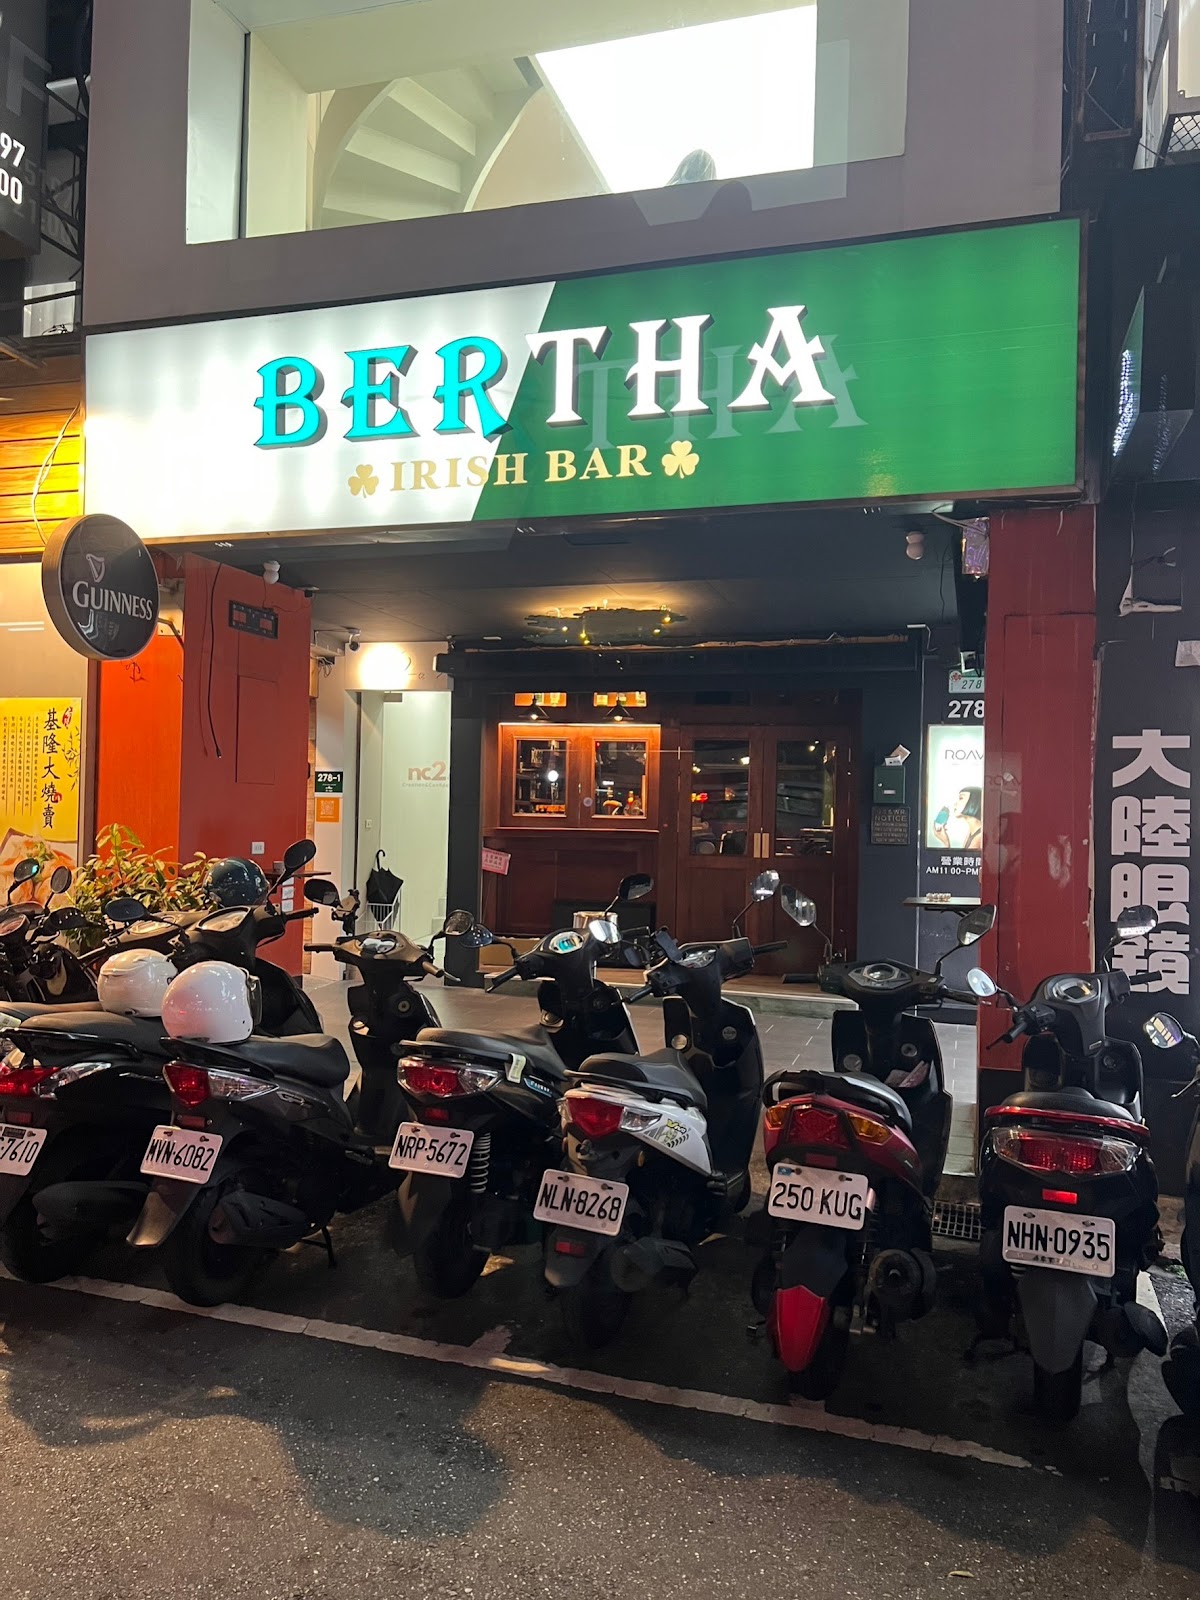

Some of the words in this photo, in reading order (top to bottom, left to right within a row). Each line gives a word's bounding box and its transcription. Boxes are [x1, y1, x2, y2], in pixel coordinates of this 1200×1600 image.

[253, 304, 837, 449] BERTHA
[389, 451, 529, 493] IRISH
[545, 444, 652, 483] BAR
[72, 580, 153, 621] GUINNESS
[961, 679, 983, 690] 278
[947, 700, 985, 718] 278
[41, 707, 62, 829] 基隆大燒賣
[317, 773, 341, 782] 278-1
[1110, 728, 1191, 995] 大陸眼鏡
